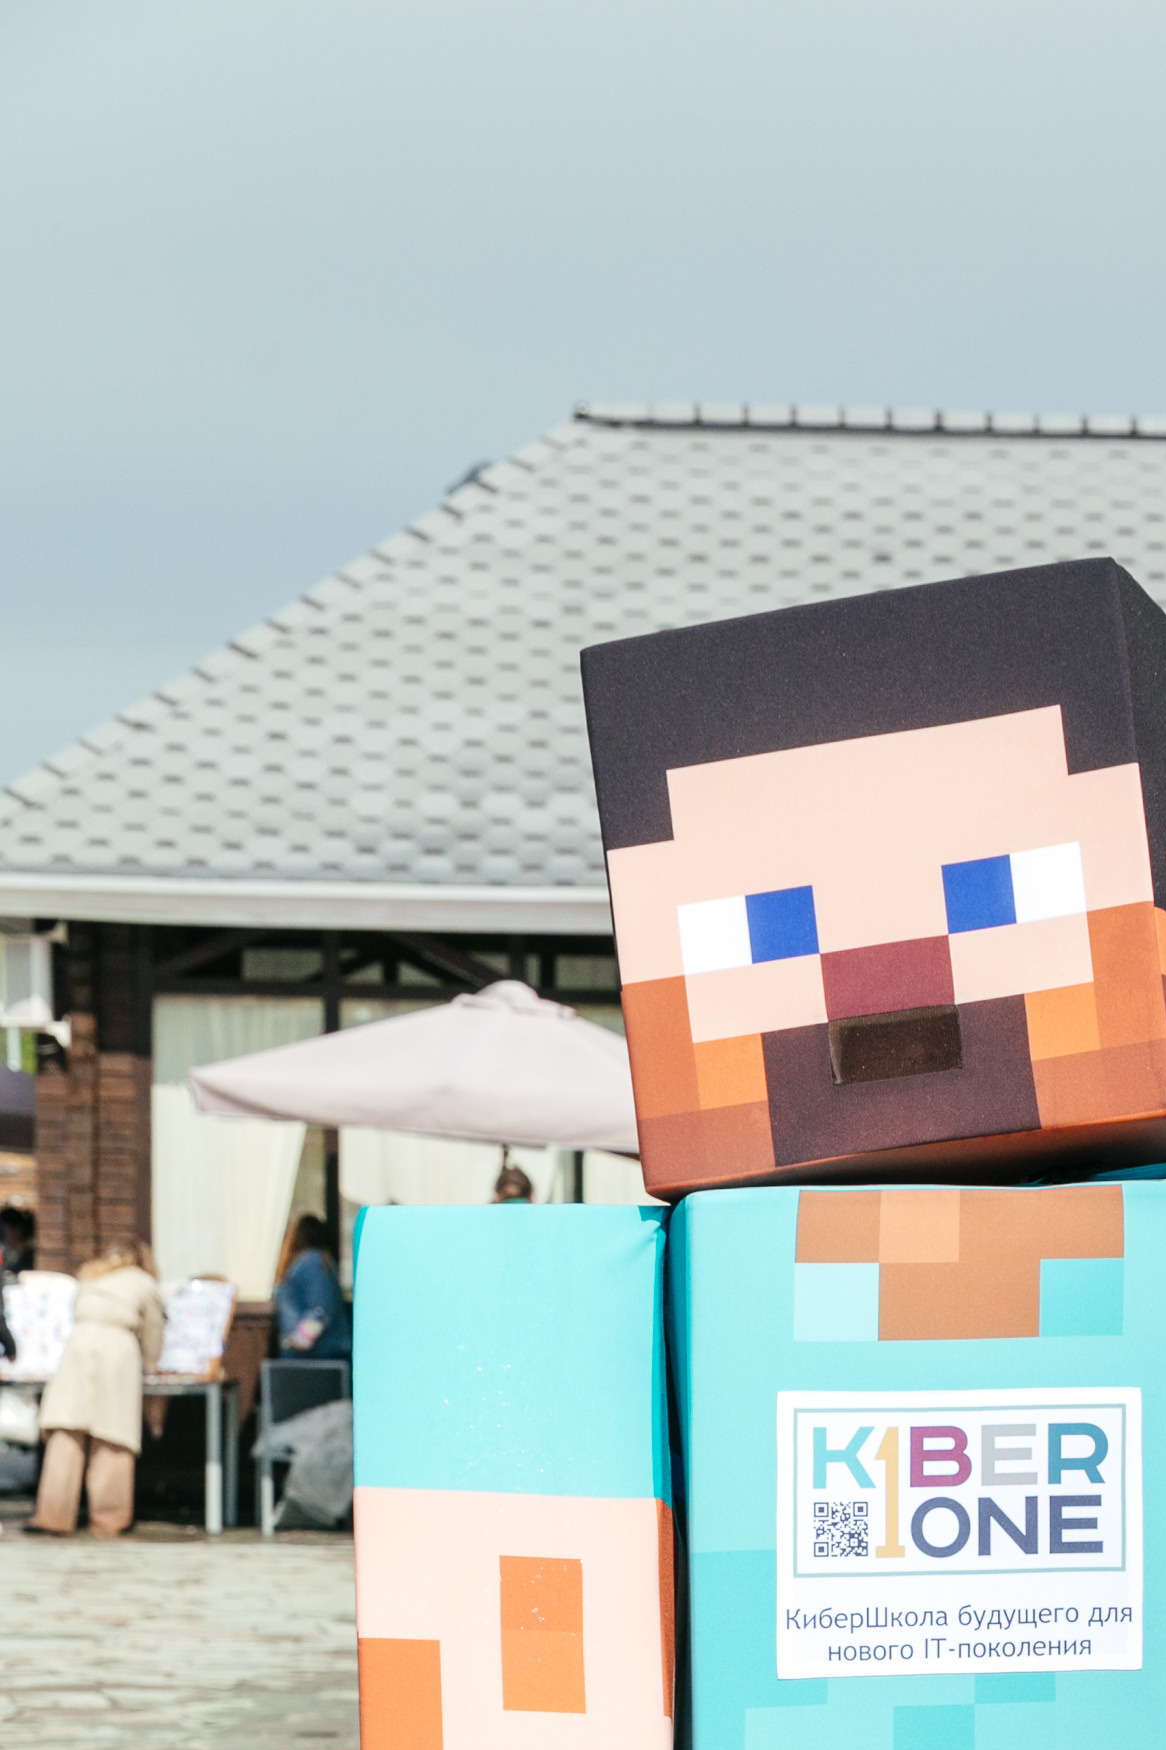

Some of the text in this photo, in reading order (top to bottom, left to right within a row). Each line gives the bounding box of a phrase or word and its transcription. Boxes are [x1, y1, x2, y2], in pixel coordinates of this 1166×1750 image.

[911, 1494, 1103, 1558] ONE
[786, 1604, 1133, 1634] КиберШкола будущего для
[828, 1636, 1092, 1662] нового IT-поколения
